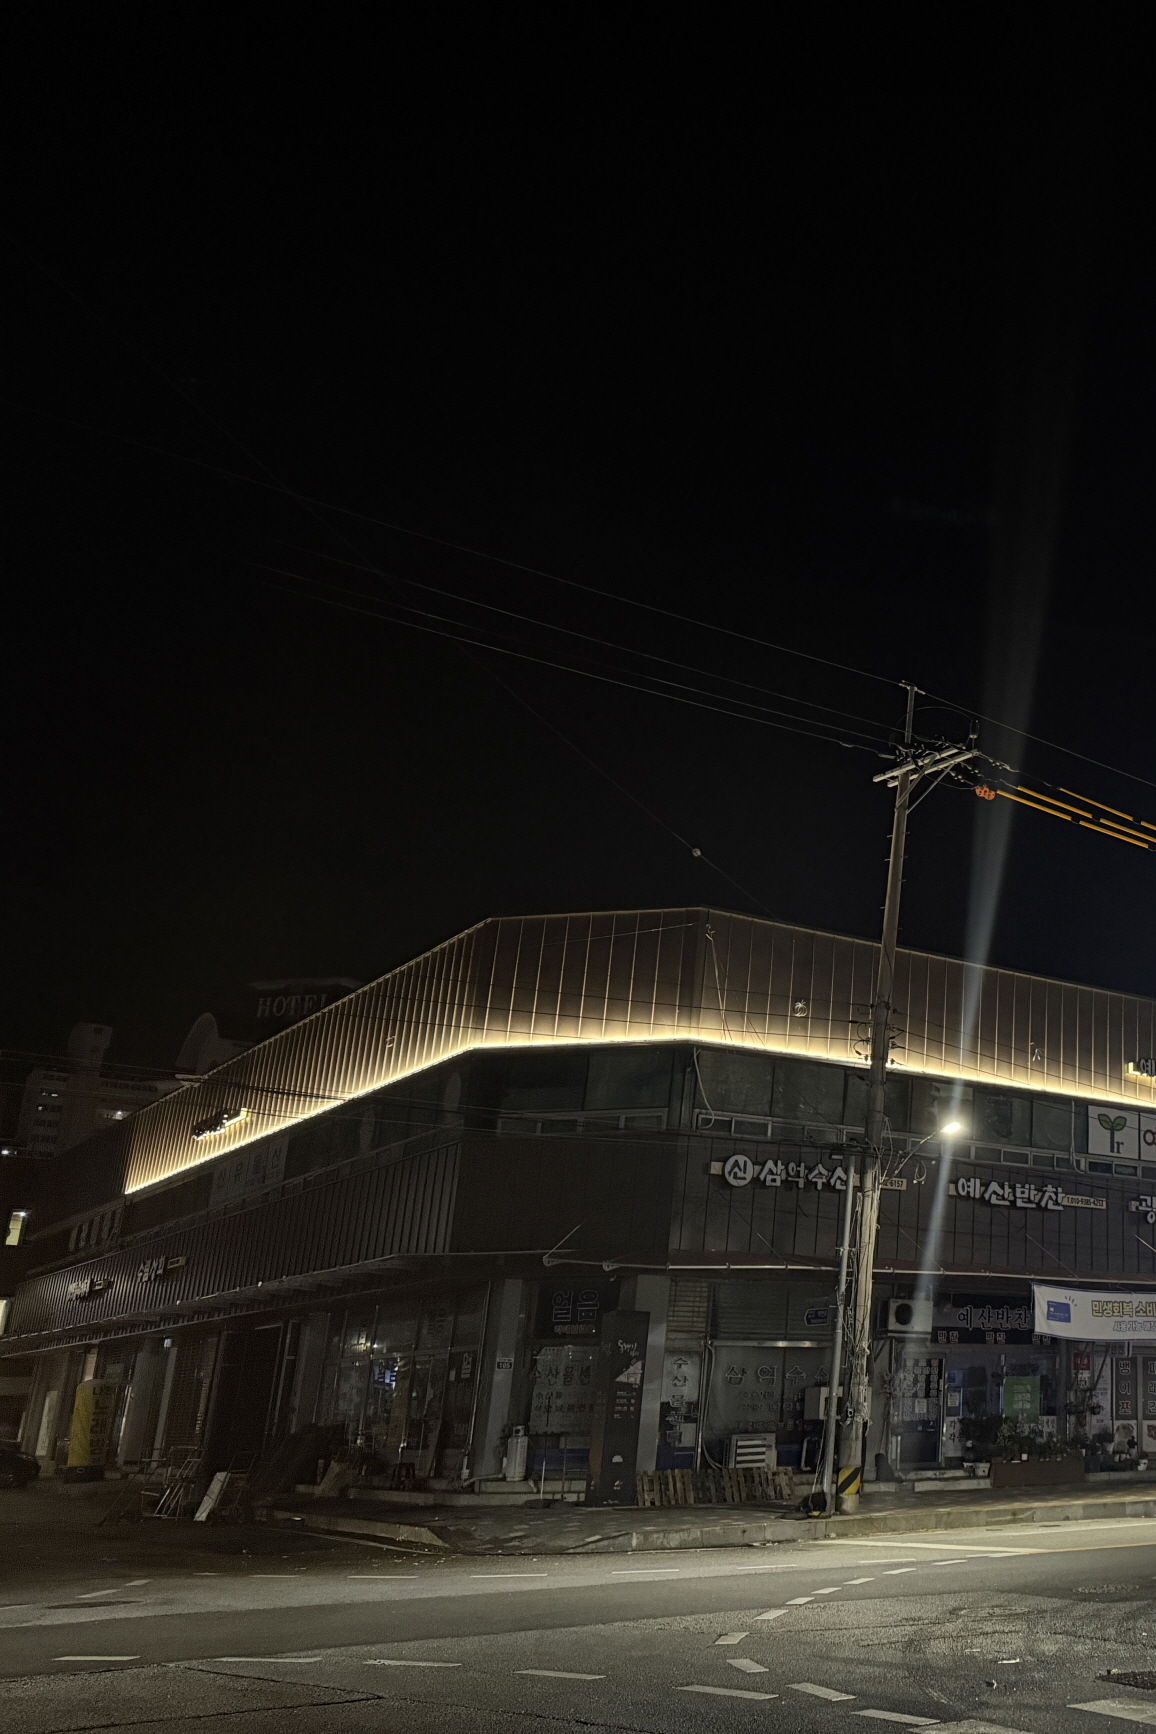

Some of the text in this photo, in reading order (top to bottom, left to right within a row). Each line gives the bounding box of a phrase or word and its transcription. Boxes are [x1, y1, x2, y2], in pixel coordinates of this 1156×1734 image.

[957, 1177, 1065, 1211] 예산반찬
[552, 1289, 600, 1322] 얼음
[958, 1305, 1030, 1332] 예산반찬
[1091, 1300, 1134, 1318] 민생회복
